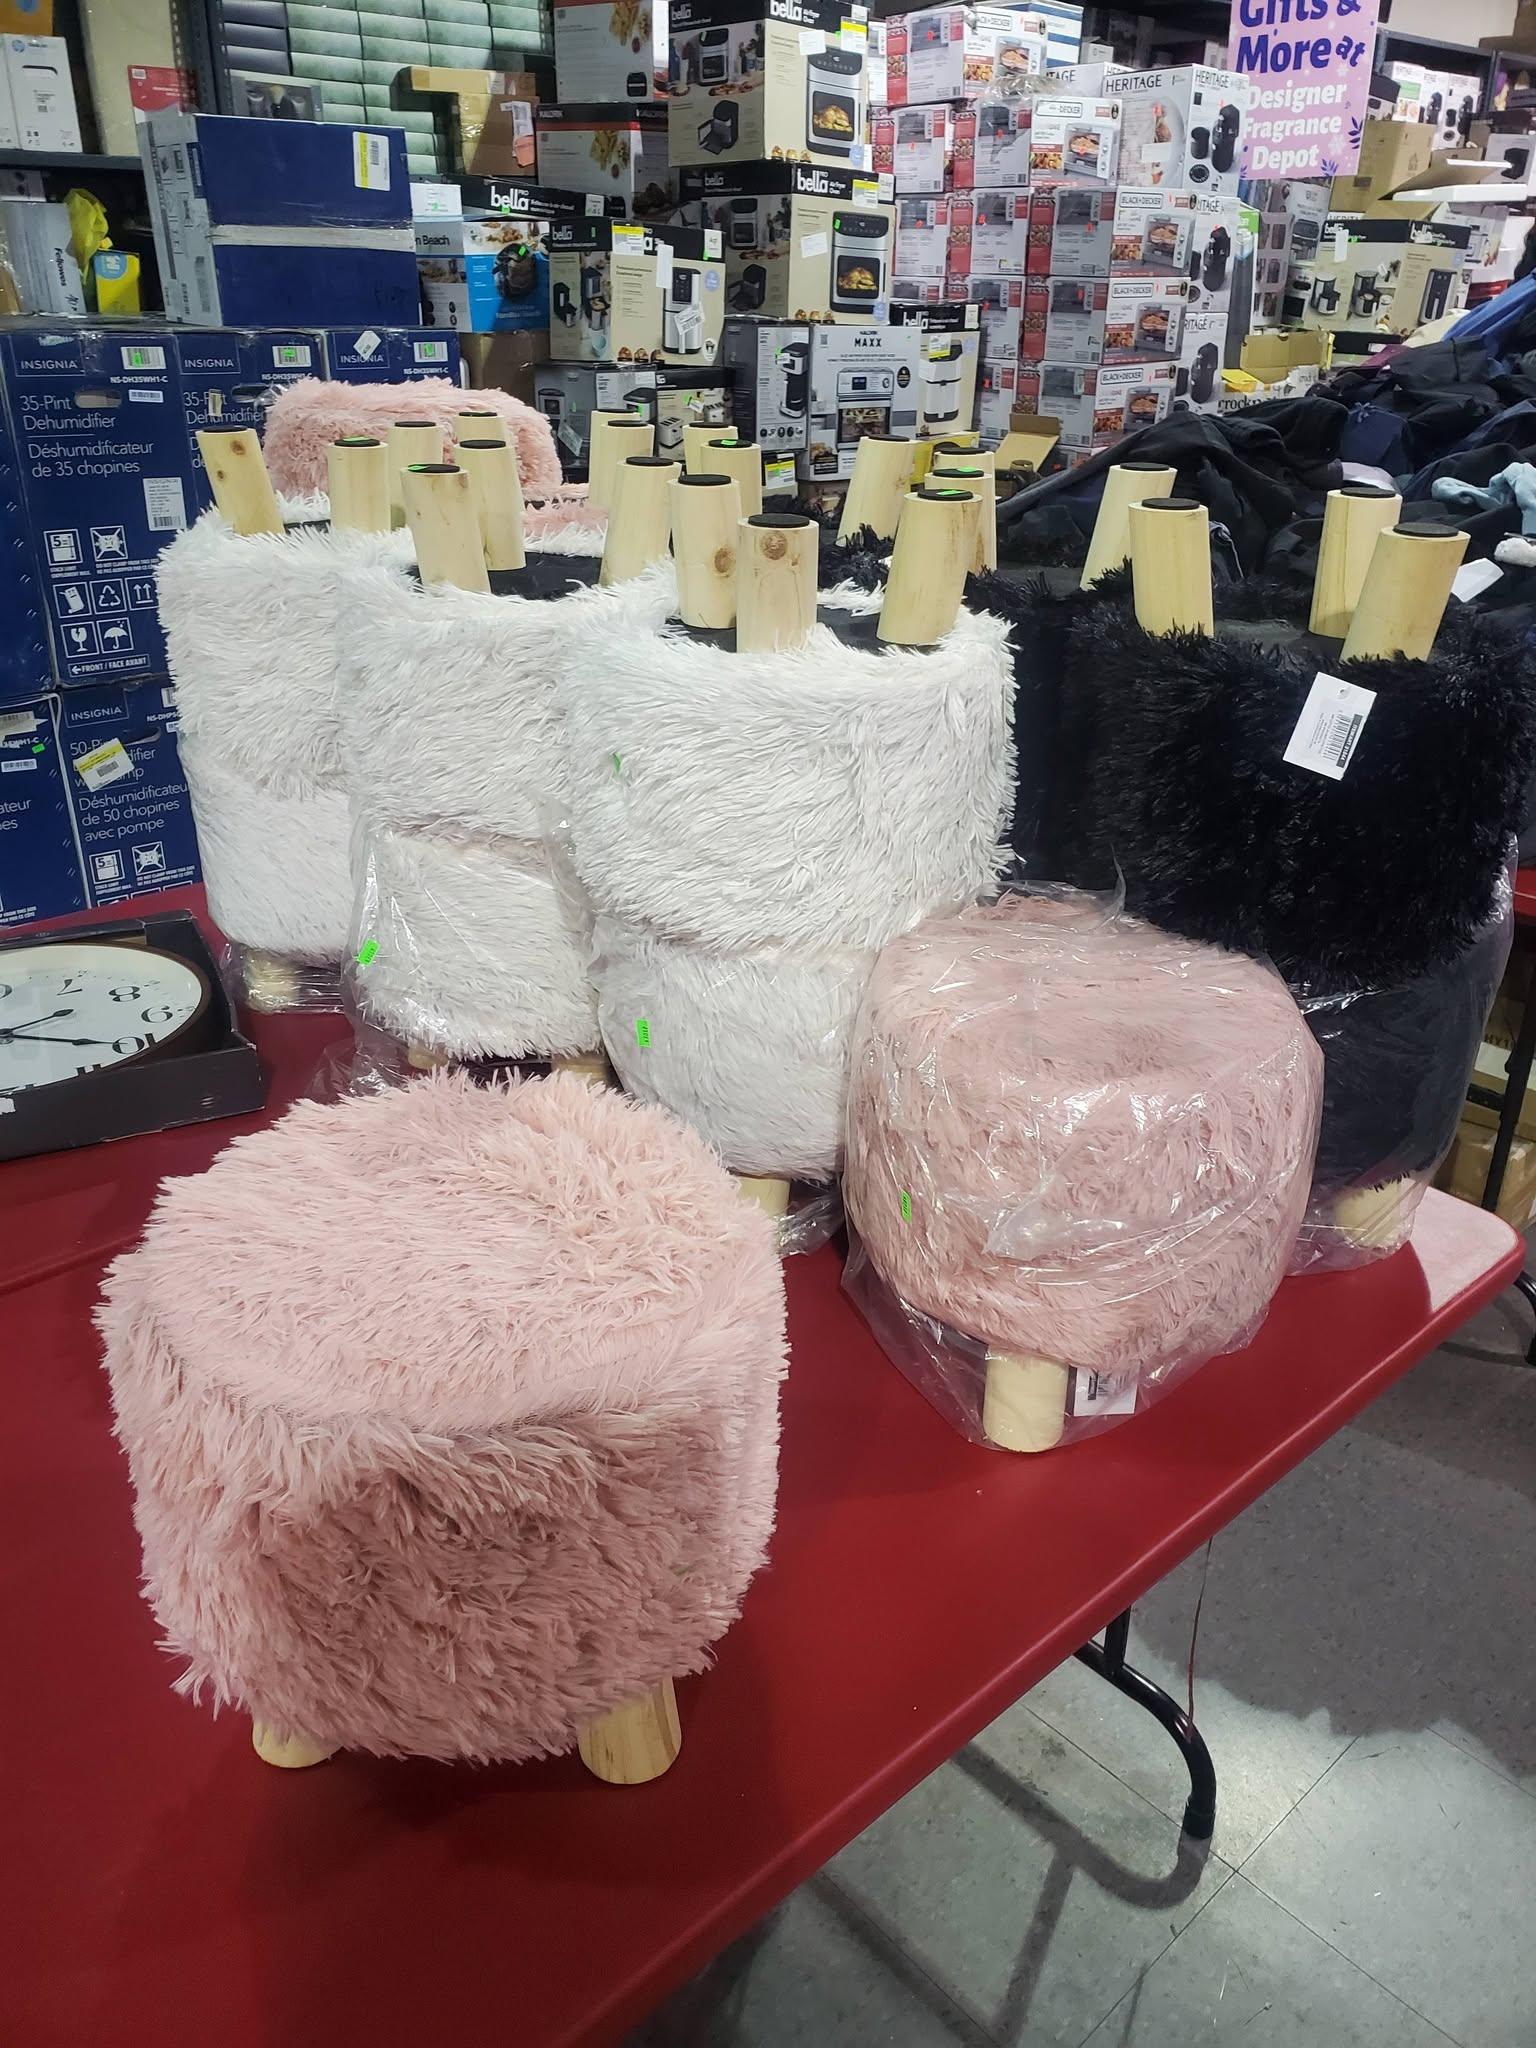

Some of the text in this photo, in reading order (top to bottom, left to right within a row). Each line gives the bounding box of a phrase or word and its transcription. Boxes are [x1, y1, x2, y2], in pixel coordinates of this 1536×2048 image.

[1236, 34, 1366, 74] More at
[1105, 75, 1162, 93] HERITAGE
[1195, 69, 1229, 89] HERITAGE
[1248, 80, 1347, 113] Designer
[1243, 116, 1342, 143] Fragrance
[1252, 145, 1319, 175] Depot
[797, 168, 828, 194] bella
[491, 186, 529, 211] bella
[423, 235, 450, 246] Beach
[552, 226, 573, 241] bella
[854, 338, 882, 347] MAXX
[20, 360, 78, 370] INSIGNIA
[184, 359, 235, 368] INSIGNIA
[19, 395, 72, 411] 35-Pint
[23, 412, 116, 431] Dehumidifier
[28, 440, 154, 459] Déshumidificateur
[32, 460, 141, 478] de 35 chopines
[81, 663, 104, 673] FRONT
[109, 660, 125, 669] FACE
[126, 657, 147, 667] AVANT
[71, 706, 122, 721] INSIGNIA
[81, 800, 180, 827] de 50 chopines
[85, 819, 165, 842] avec pompe
[109, 986, 141, 1003] 8
